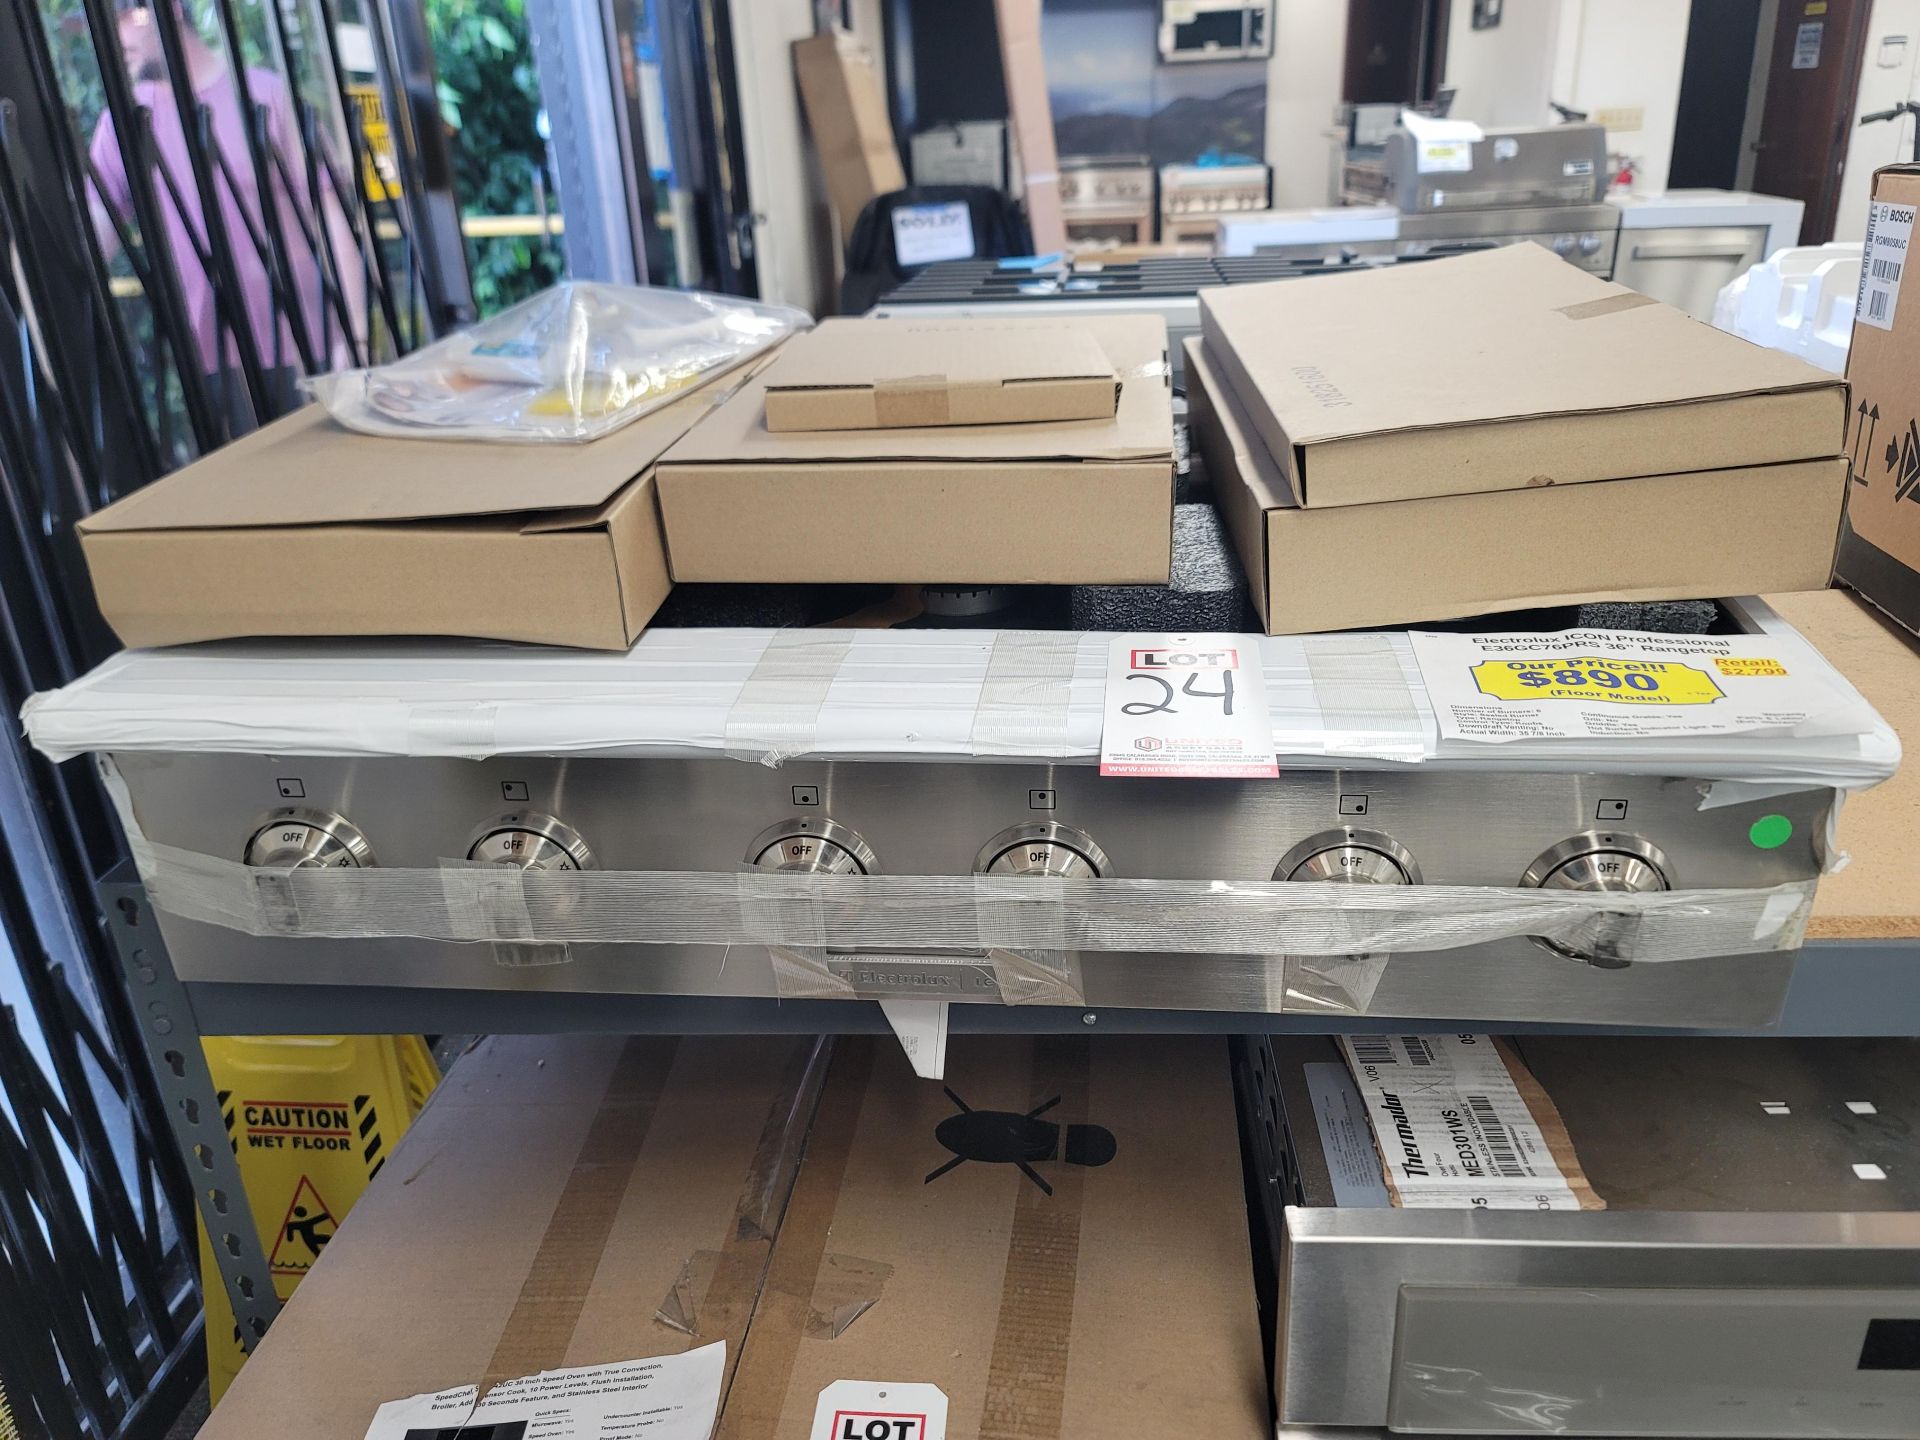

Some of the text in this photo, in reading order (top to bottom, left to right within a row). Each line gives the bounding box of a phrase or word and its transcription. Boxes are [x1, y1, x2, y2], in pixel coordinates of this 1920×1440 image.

[1890, 209, 1914, 224] BOSCH
[1472, 633, 1730, 647] Electrolux ICON Professional
[1481, 641, 1600, 651] E36GC76PRS
[1641, 644, 1730, 656] Rangetop
[1144, 653, 1225, 666] LOT
[1507, 660, 1668, 673] Our Price!!!
[1713, 658, 1781, 667] Retail:
[1518, 670, 1659, 691] $890
[1121, 669, 1234, 716] 24
[1550, 689, 1672, 702] (Floor Model)
[282, 832, 303, 842] OFF
[503, 840, 523, 850] OFF
[791, 845, 812, 855] OFF
[1030, 852, 1050, 862] OFF
[1340, 856, 1362, 867] OFF
[1597, 862, 1620, 873] OFF
[860, 968, 953, 987] Electrolux
[1364, 1065, 1380, 1082] V06
[245, 1107, 348, 1129] CAUTION
[247, 1135, 352, 1150] WET FLOOR
[1381, 1091, 1429, 1179] Thermador
[1442, 1109, 1486, 1177] MED301WS
[1478, 1143, 1501, 1177] STAINLESS
[1471, 1197, 1488, 1210] 5
[514, 1379, 524, 1387] 30
[525, 1377, 541, 1385] Inch
[543, 1375, 565, 1384] Speed
[621, 1363, 663, 1374] Convection,
[506, 1387, 527, 1396] Cook,
[539, 1384, 562, 1392] Power
[564, 1380, 589, 1389] Levels,
[613, 1374, 655, 1383] Installation,
[431, 1402, 457, 1411] Broiler,
[459, 1399, 473, 1408] Add
[487, 1398, 519, 1407] Seconds
[520, 1395, 549, 1404] Feature,
[567, 1388, 600, 1397] Stainless
[602, 1386, 621, 1394] Steel
[621, 1383, 648, 1392] Interior
[843, 1418, 915, 1440] LOT
